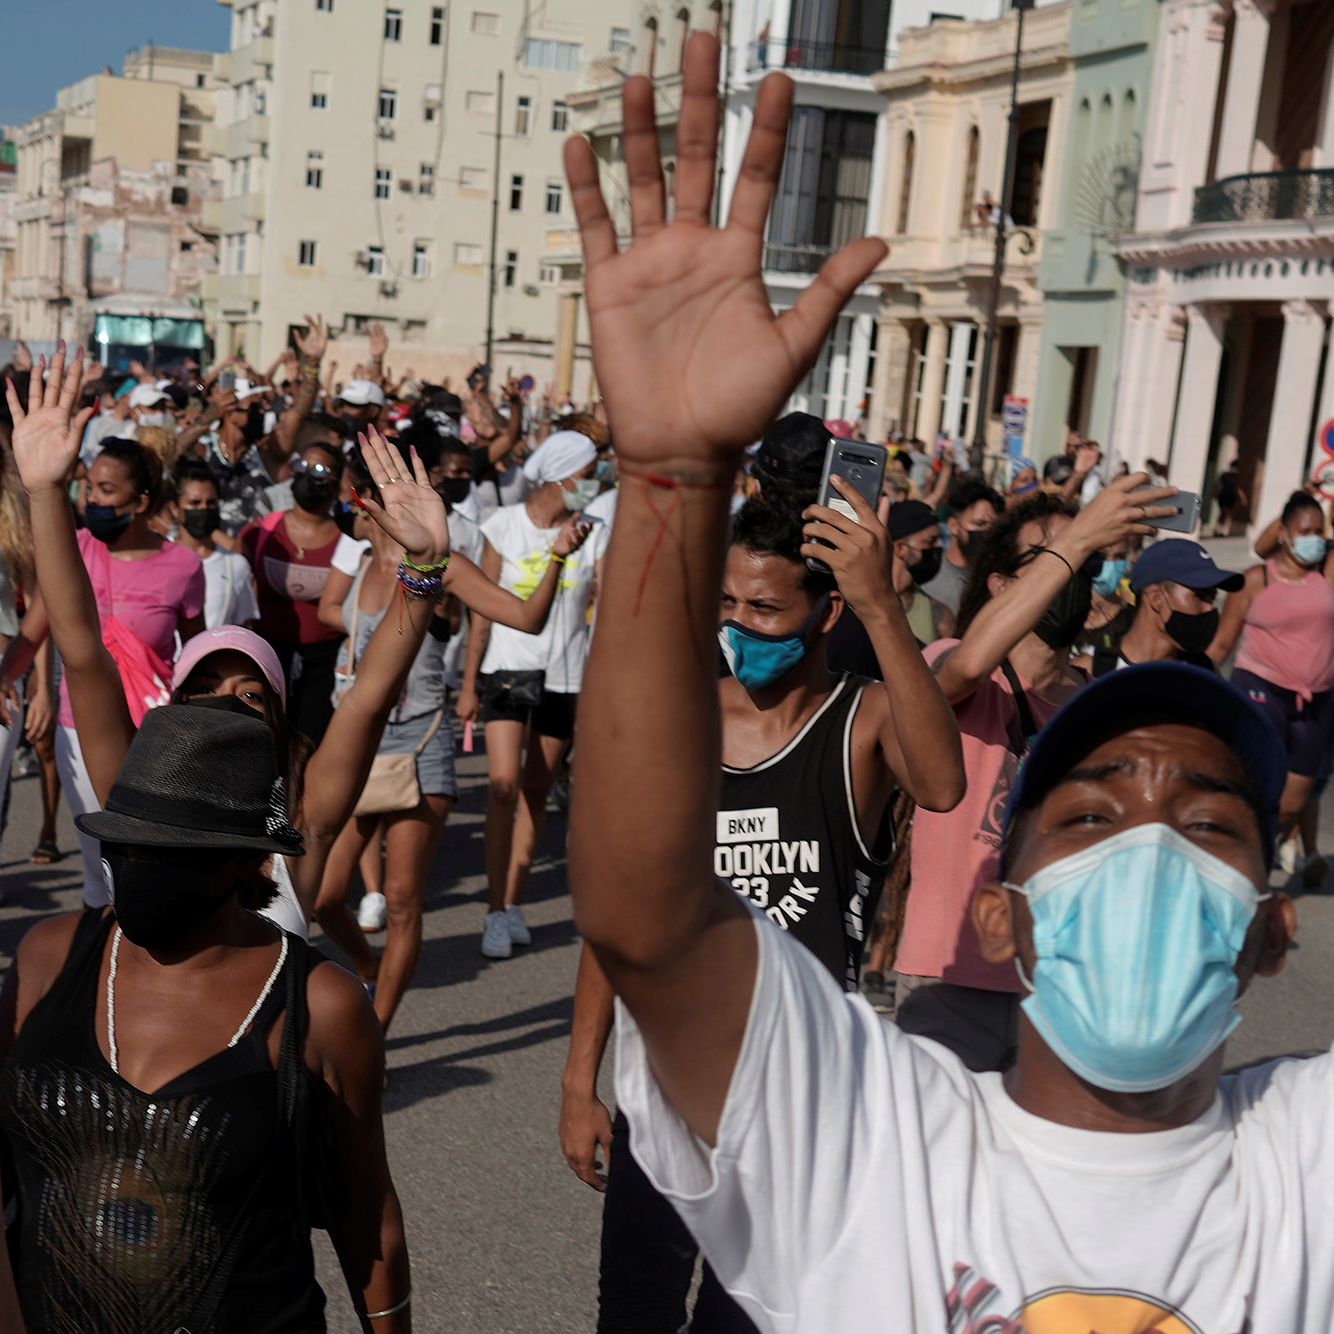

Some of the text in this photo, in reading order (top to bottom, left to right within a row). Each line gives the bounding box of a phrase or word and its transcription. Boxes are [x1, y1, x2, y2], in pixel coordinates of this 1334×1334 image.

[728, 816, 766, 835] BKNY
[714, 840, 820, 878] OOKLYN
[765, 877, 820, 930] ORK
